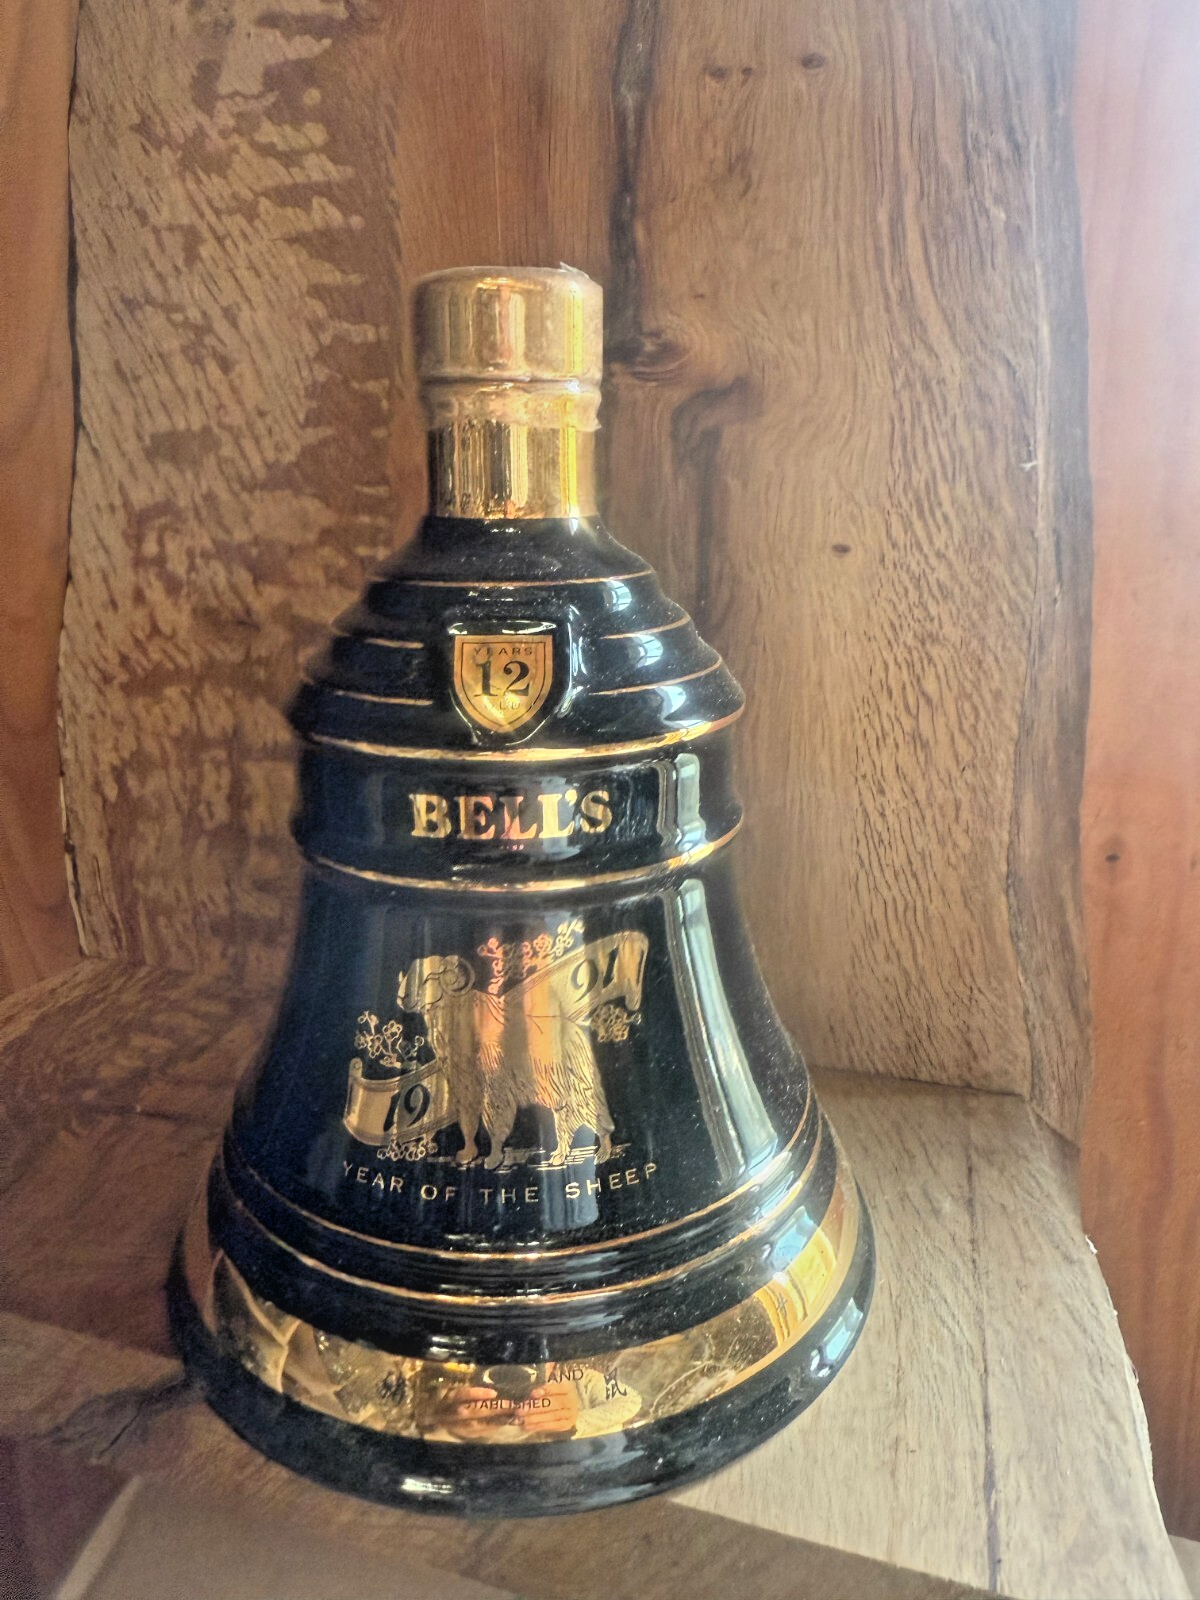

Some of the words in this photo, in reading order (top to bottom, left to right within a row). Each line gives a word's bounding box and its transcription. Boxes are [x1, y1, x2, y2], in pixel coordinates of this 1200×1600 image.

[473, 660, 531, 698] 12
[409, 789, 613, 840] BELL'S
[342, 1159, 405, 1194] YEAR
[420, 1183, 458, 1203] OF
[478, 1186, 540, 1204] THE
[564, 1162, 658, 1199] SHEEP
